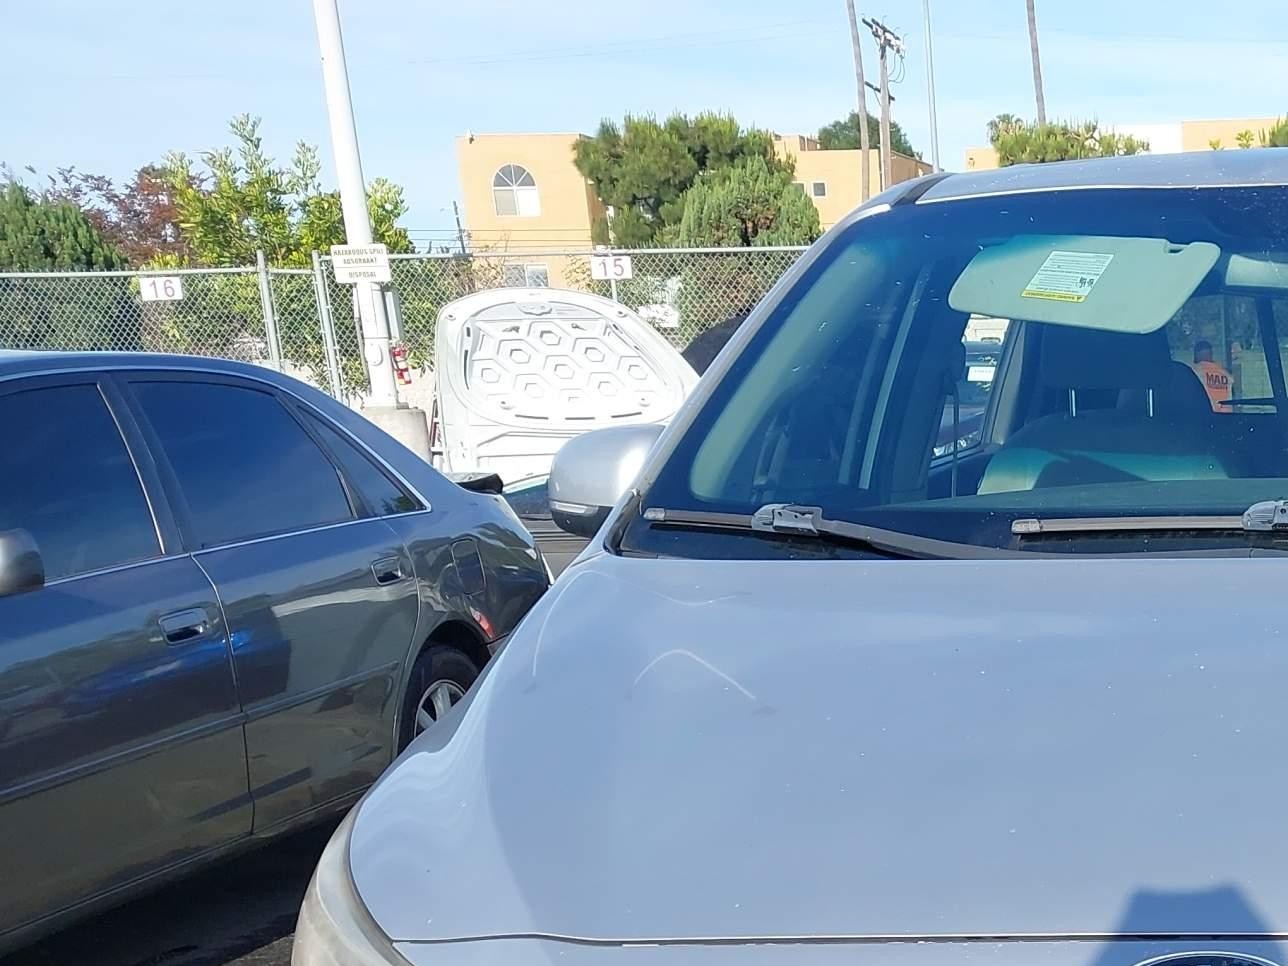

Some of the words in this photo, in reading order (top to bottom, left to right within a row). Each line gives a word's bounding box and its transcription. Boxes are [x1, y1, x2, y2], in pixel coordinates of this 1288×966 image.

[599, 258, 625, 277] 15
[149, 279, 175, 299] 16
[1206, 372, 1229, 385] MAD
